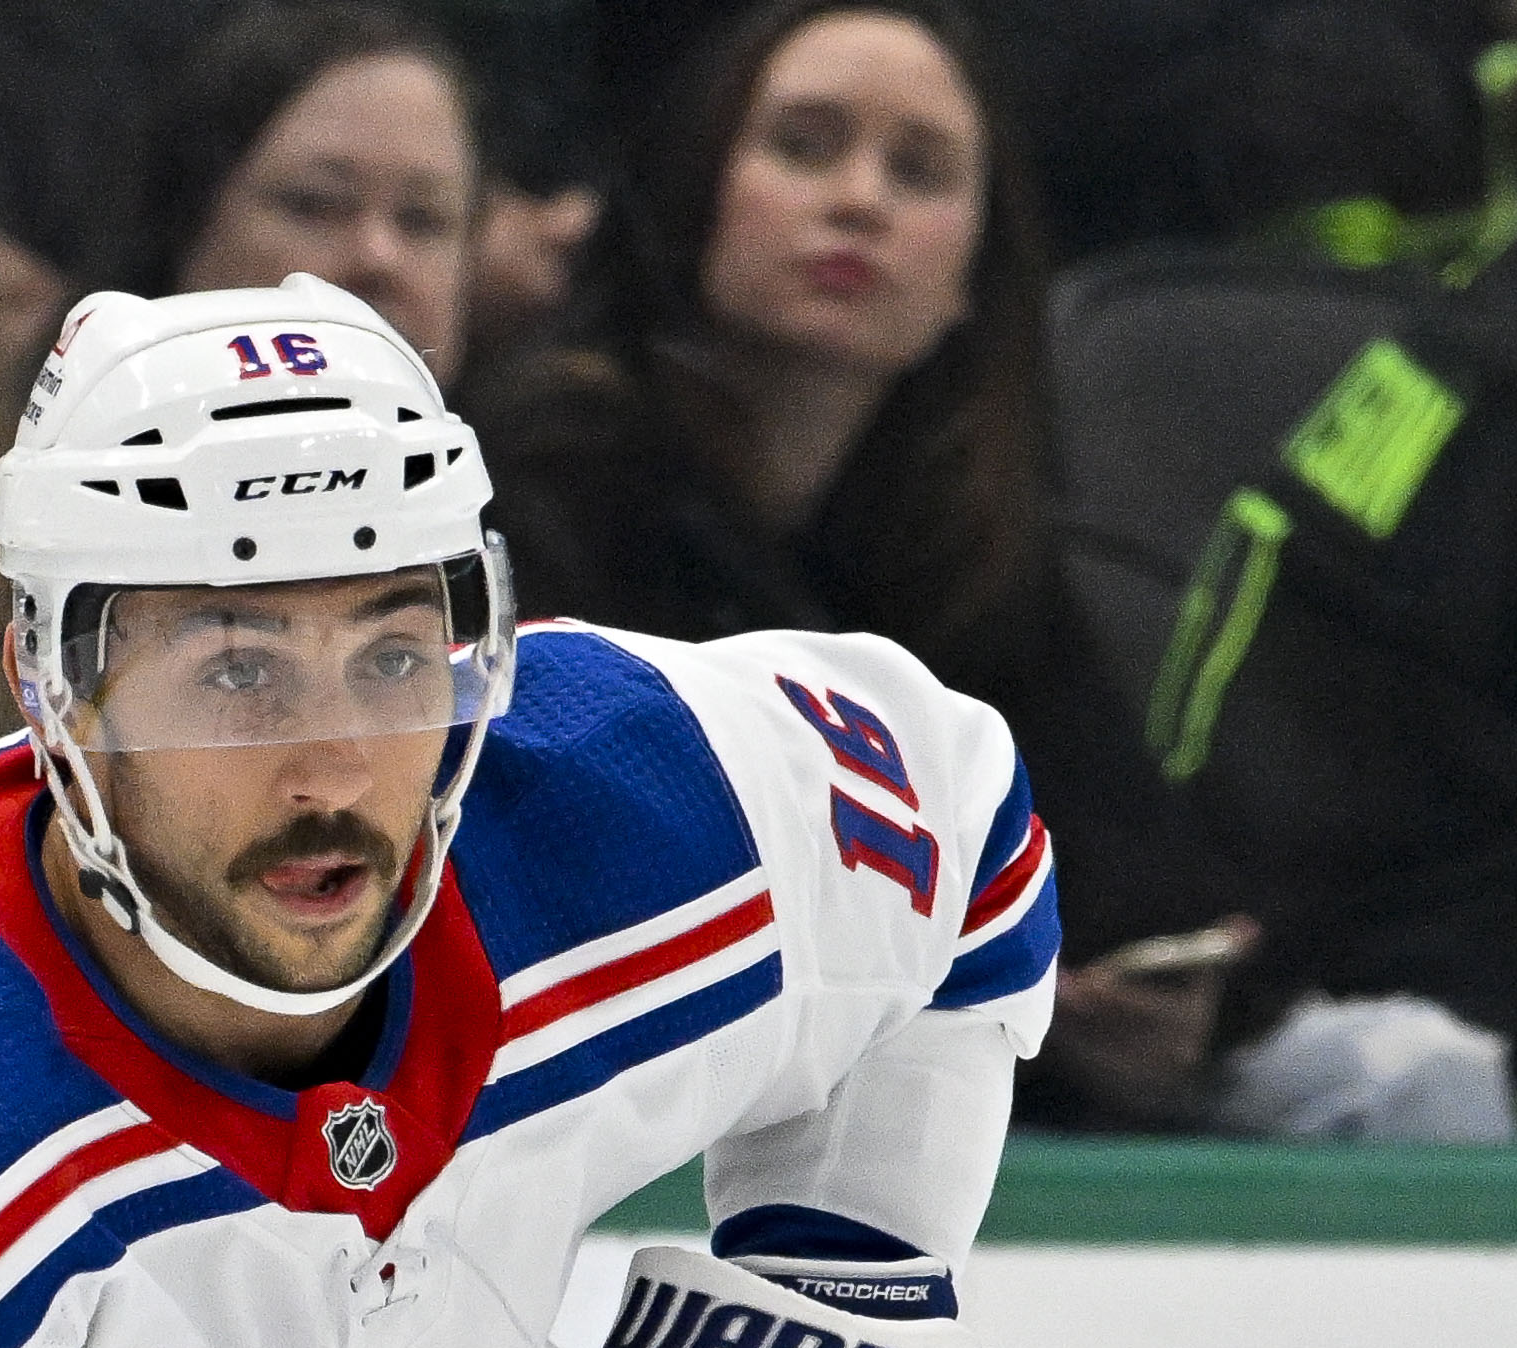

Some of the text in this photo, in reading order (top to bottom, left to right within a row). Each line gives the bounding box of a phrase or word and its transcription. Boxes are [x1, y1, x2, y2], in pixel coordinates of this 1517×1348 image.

[228, 333, 329, 380] 16
[234, 468, 368, 502] CCM
[774, 673, 940, 919] 16
[344, 1121, 377, 1176] NHL
